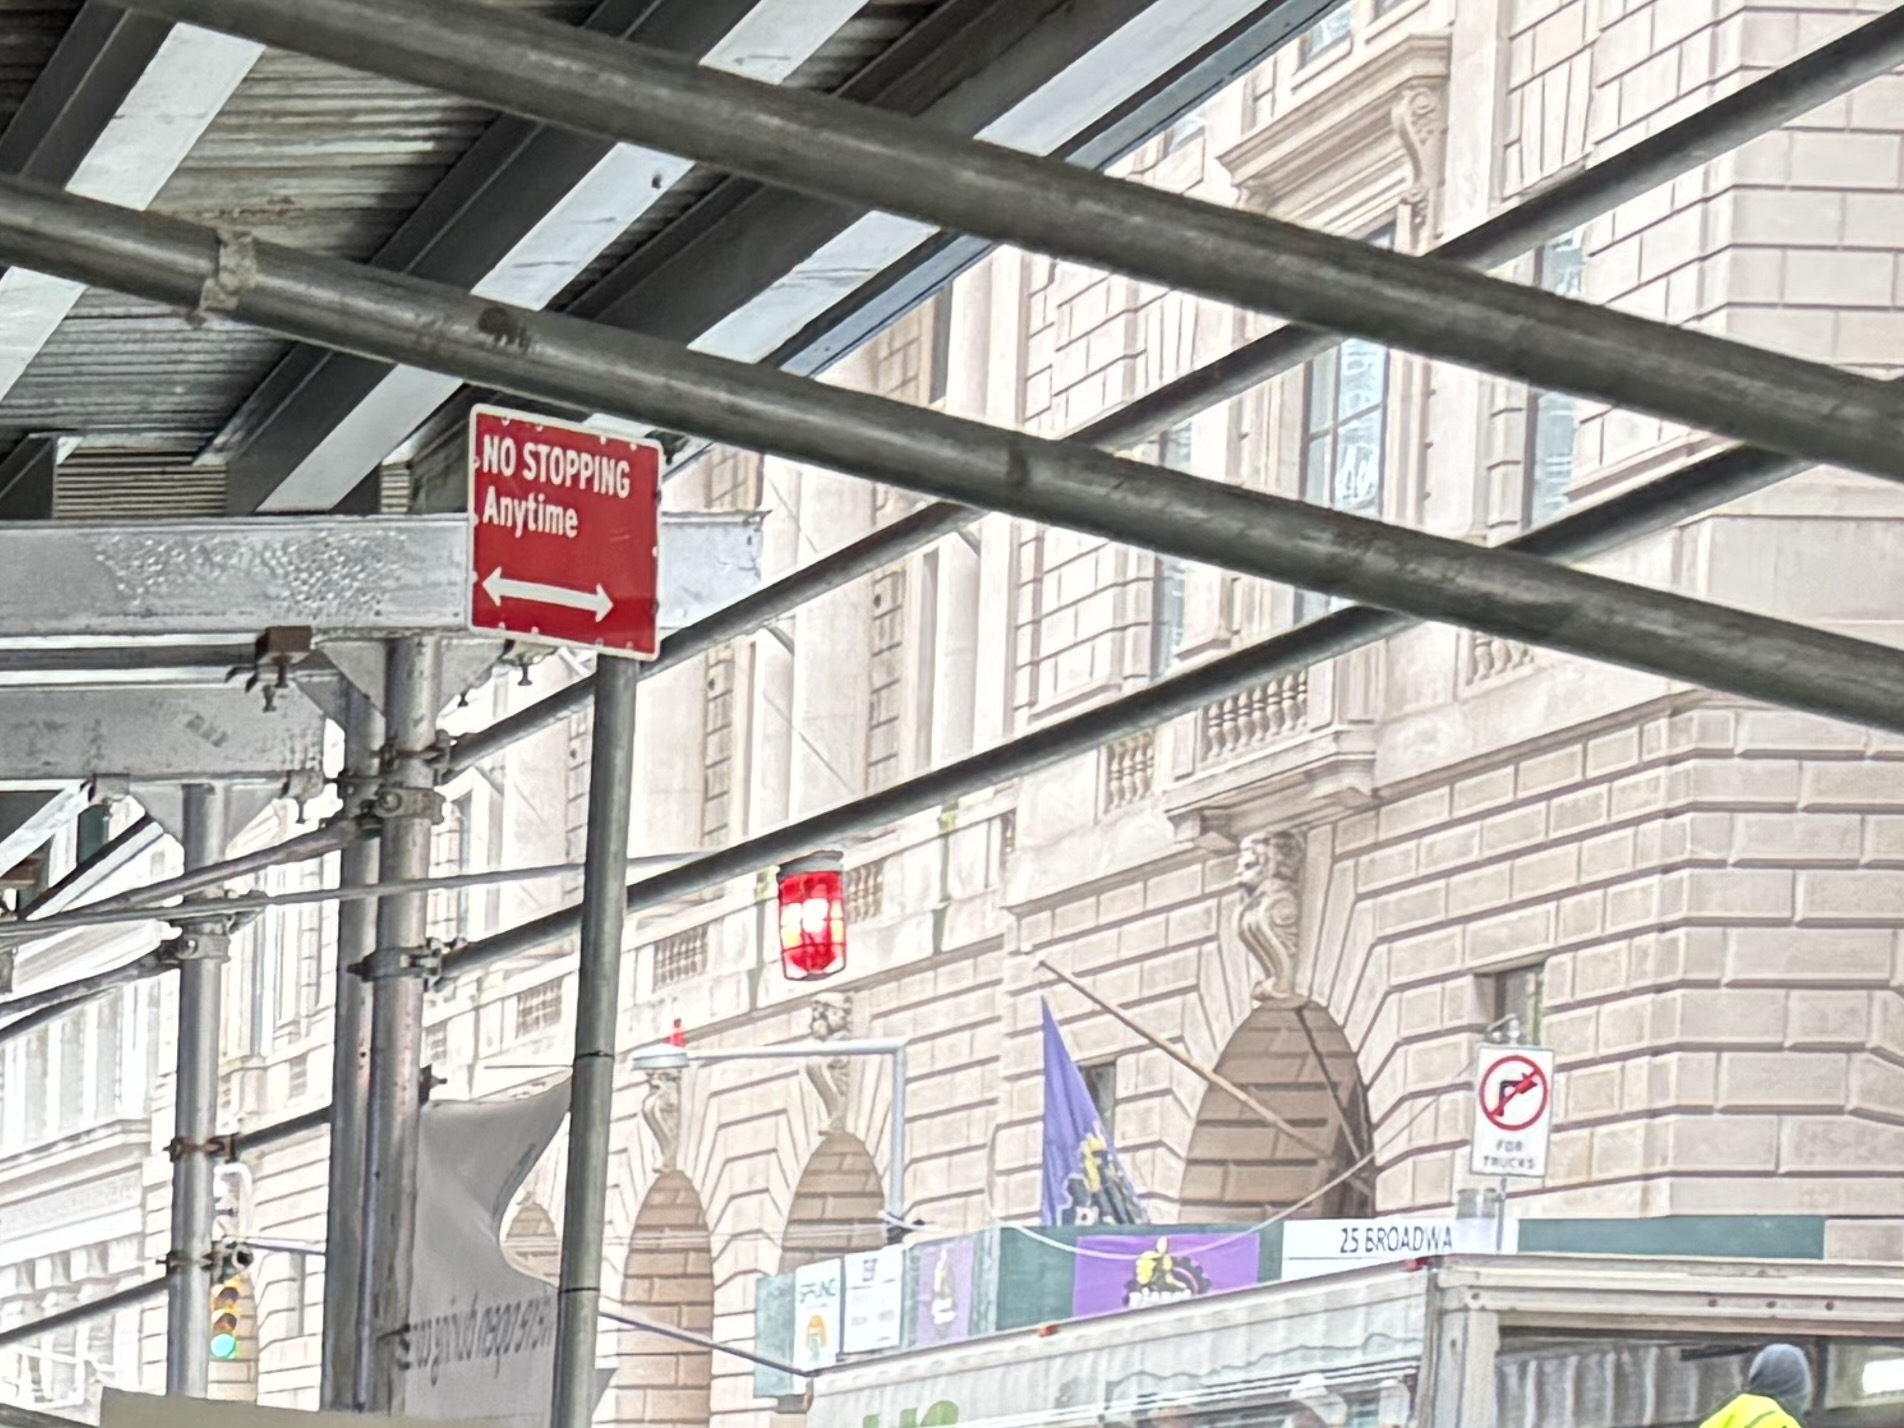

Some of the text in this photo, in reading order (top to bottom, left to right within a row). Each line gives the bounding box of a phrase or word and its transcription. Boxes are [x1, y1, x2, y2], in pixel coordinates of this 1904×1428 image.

[482, 433, 631, 500] NO STOPPING
[482, 485, 579, 538] Anytime
[1483, 1155, 1535, 1170] TRUCKS
[1339, 1227, 1359, 1253] 25
